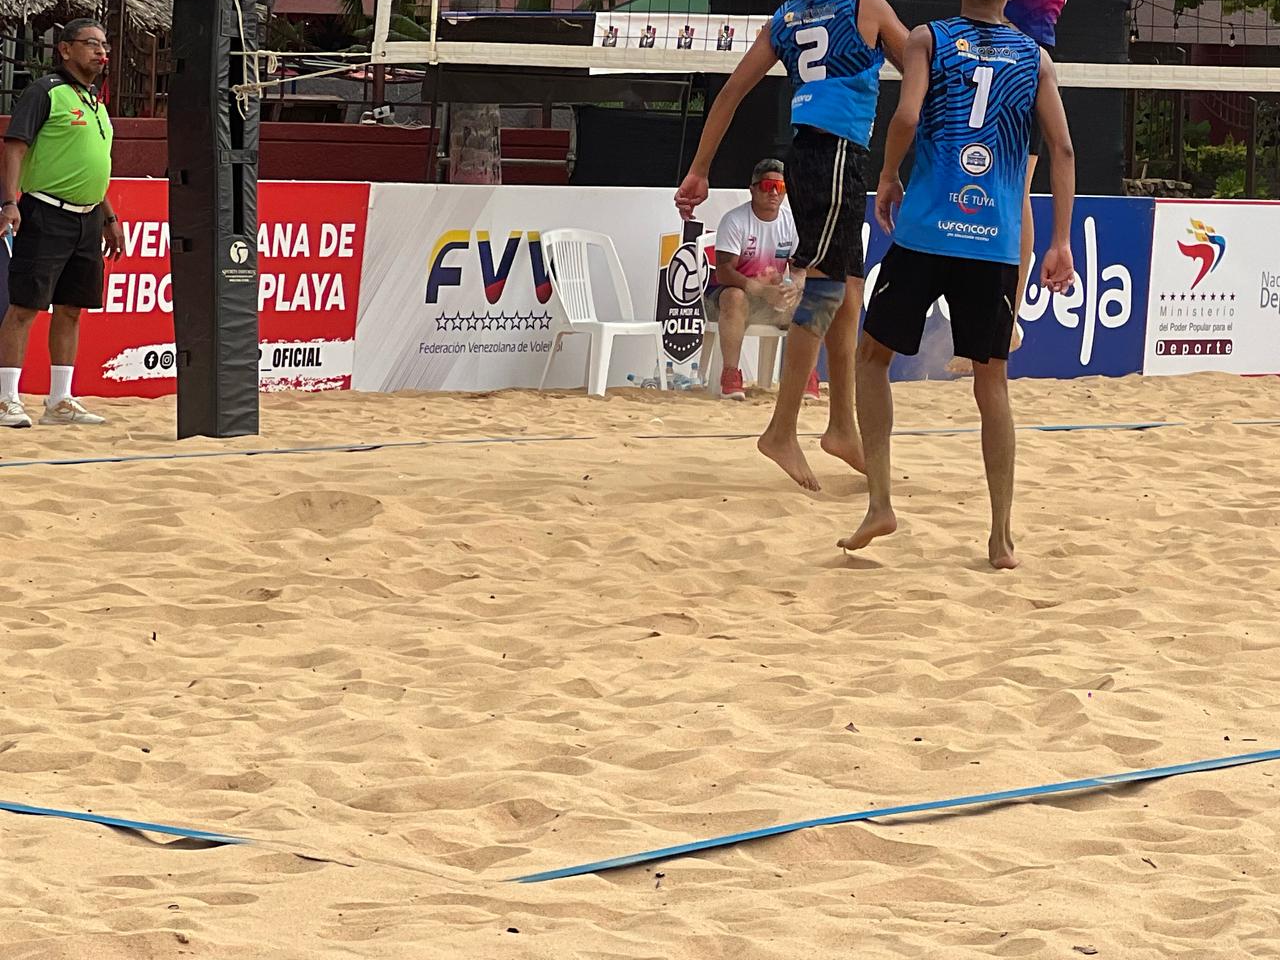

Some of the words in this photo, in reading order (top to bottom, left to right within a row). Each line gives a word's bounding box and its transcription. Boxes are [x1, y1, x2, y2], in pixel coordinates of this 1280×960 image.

[795, 25, 830, 83] 2
[968, 66, 994, 129] 1
[972, 195, 995, 208] TUYA
[319, 223, 356, 258] DE
[257, 273, 346, 312] PLAYA
[1159, 305, 1236, 317] Ministerio
[1158, 322, 1169, 332] del
[1170, 322, 1188, 332] Poder
[1189, 322, 1211, 333] Popular
[1212, 324, 1226, 333] para
[1227, 322, 1233, 331] el
[419, 341, 466, 354] Federación
[468, 340, 515, 353] Venezolana
[517, 340, 528, 353] de
[1157, 340, 1232, 356] Deporte
